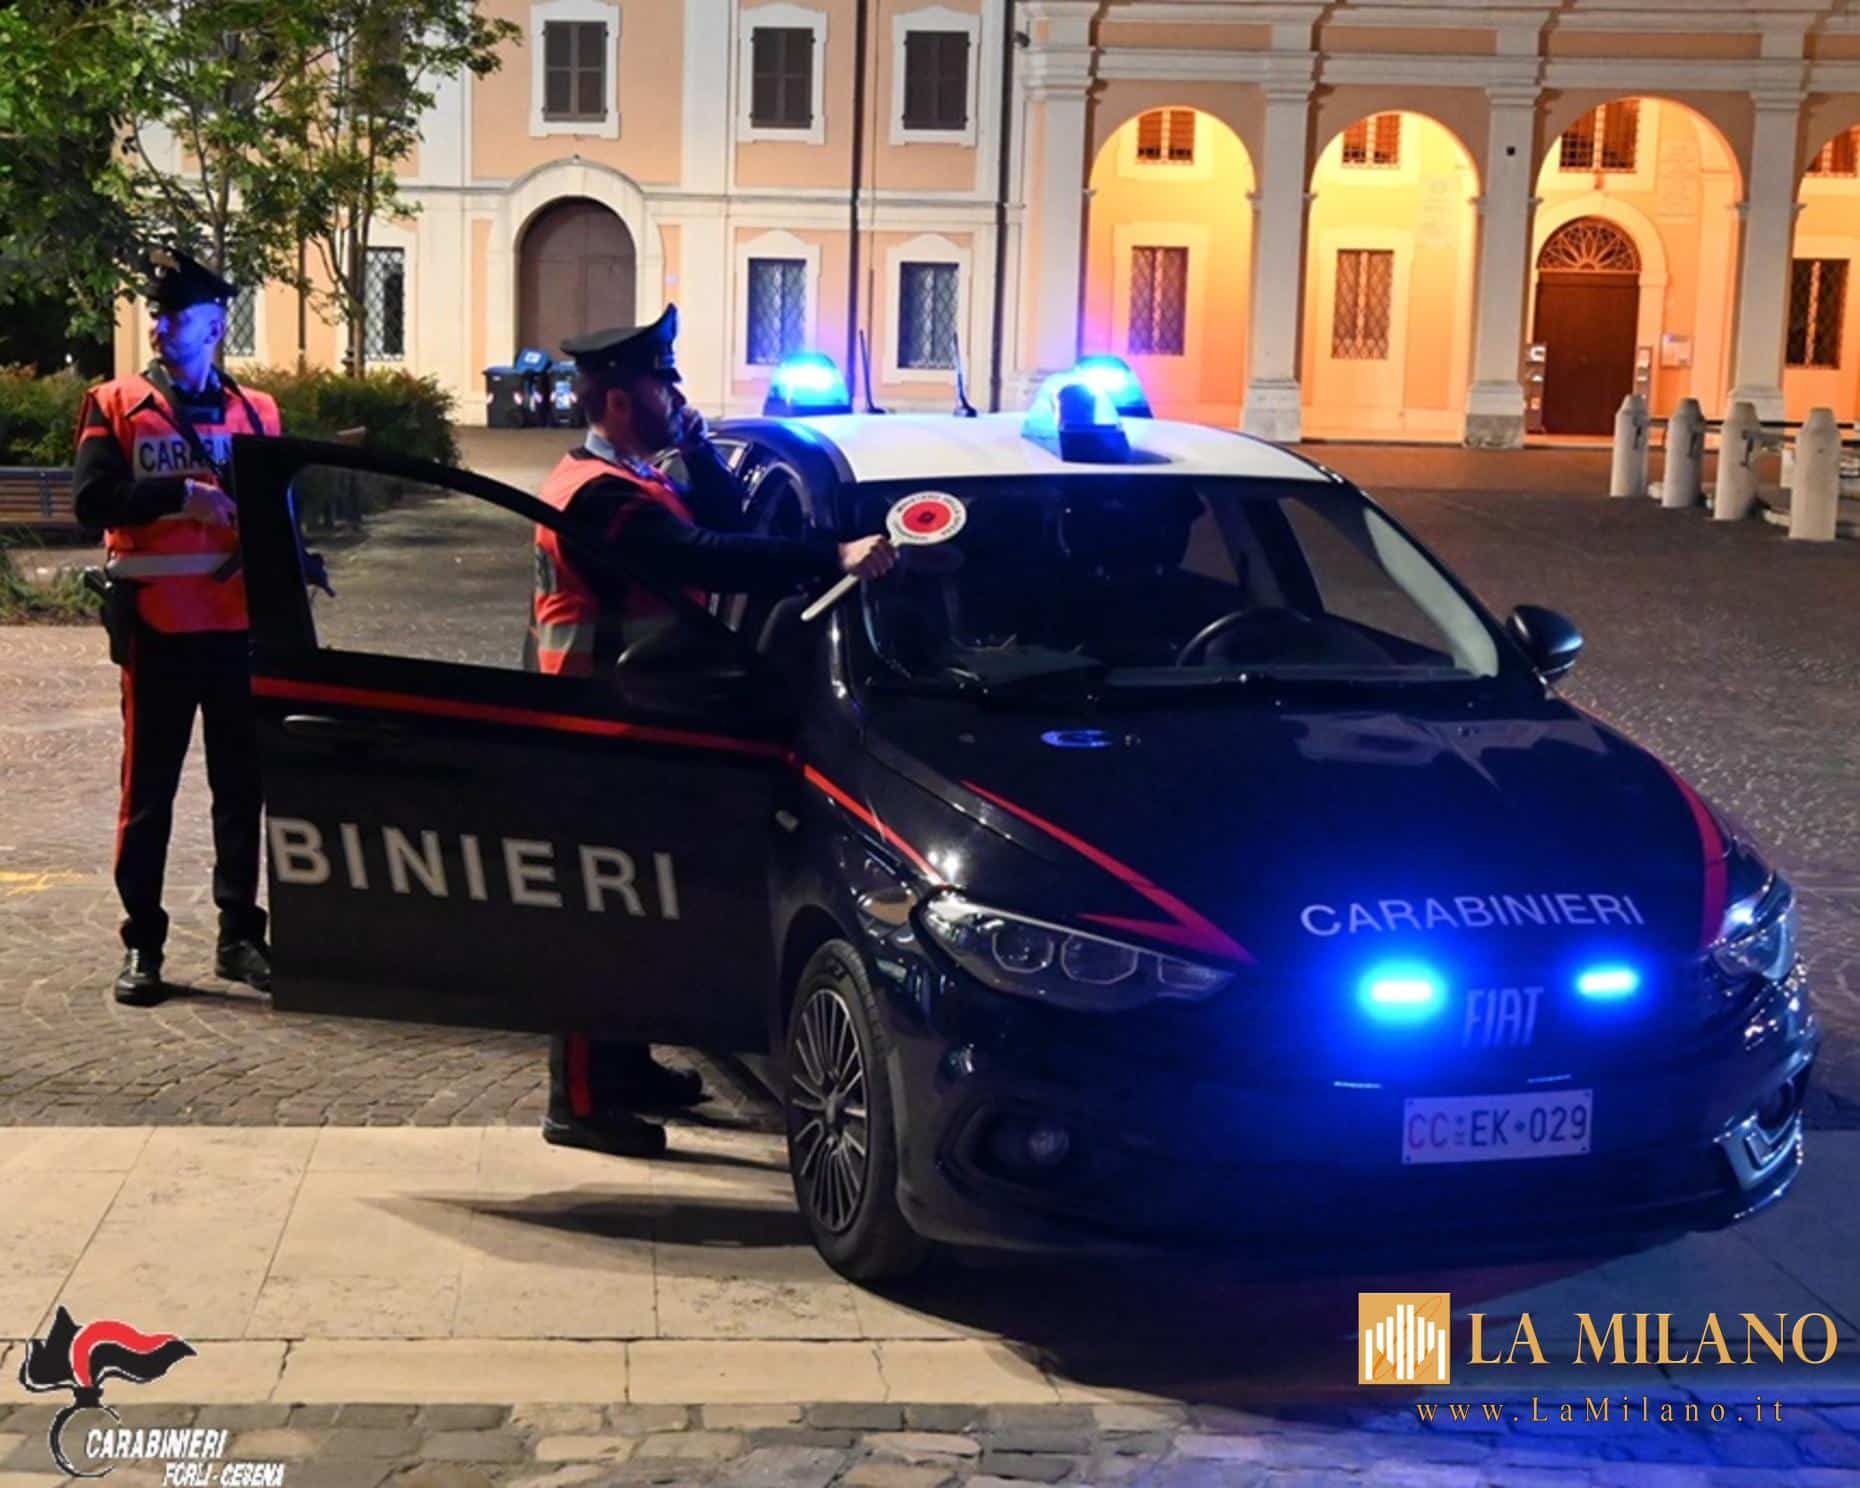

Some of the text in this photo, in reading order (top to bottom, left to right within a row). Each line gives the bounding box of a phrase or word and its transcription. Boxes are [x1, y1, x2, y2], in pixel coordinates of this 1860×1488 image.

[268, 816, 681, 920] BINIERI
[1300, 893, 1645, 936] CARABINIERI
[1462, 986, 1545, 1048] FIAT
